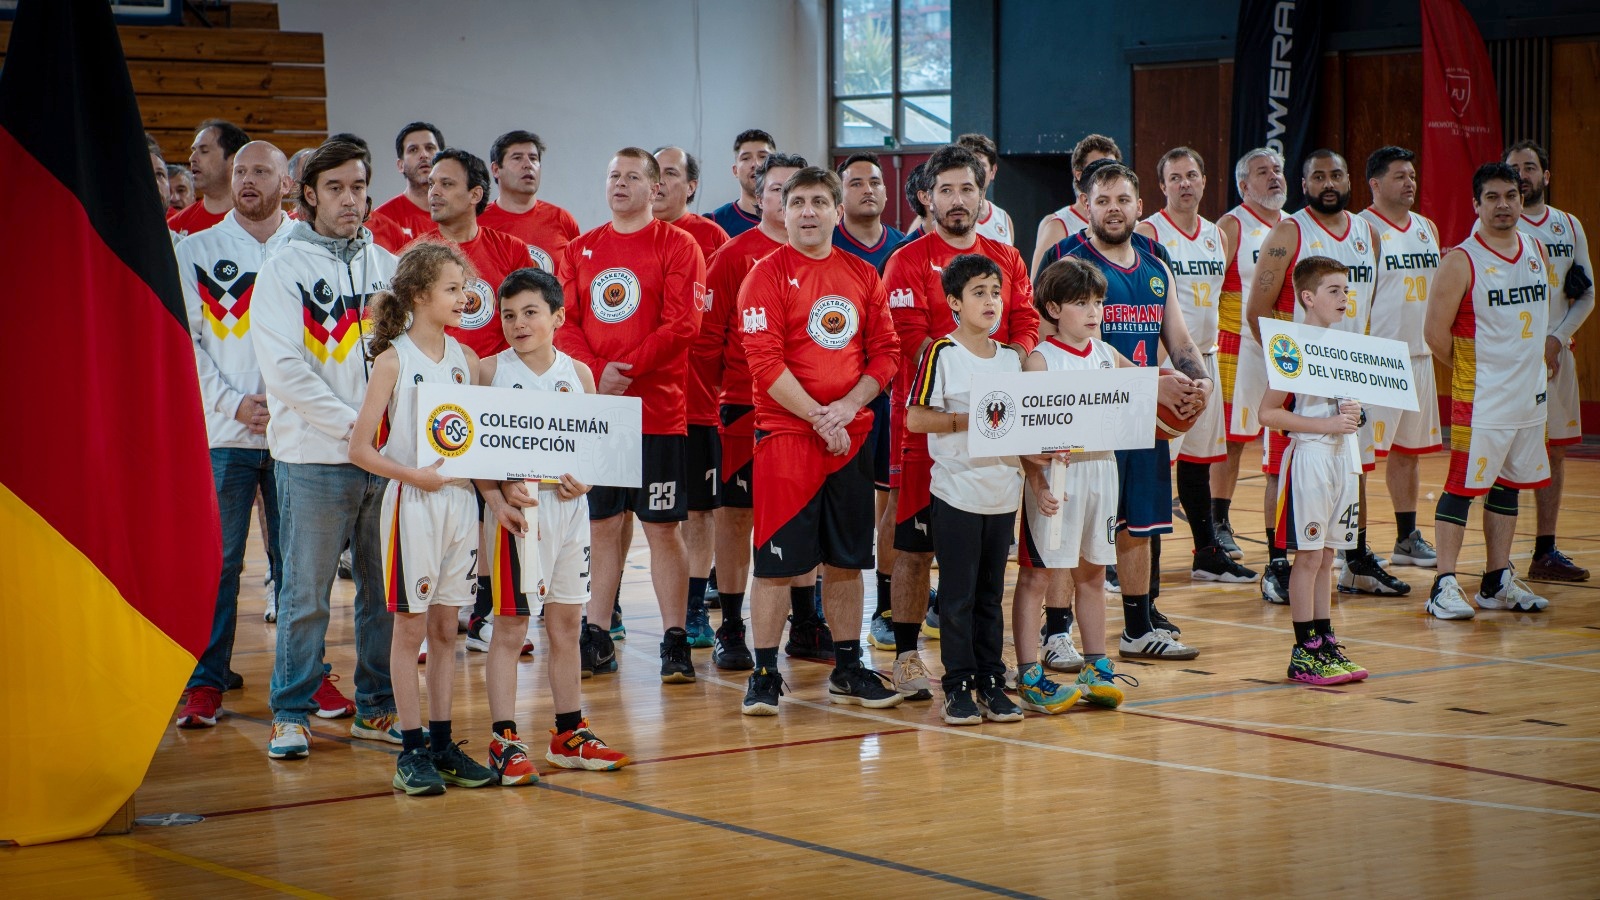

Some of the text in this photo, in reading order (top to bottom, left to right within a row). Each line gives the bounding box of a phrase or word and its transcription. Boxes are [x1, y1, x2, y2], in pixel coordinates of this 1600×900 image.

[1266, 0, 1296, 154] OWERA
[1385, 249, 1440, 271] ALEMÁN
[1545, 240, 1574, 258] MÁN
[1171, 257, 1224, 276] ALEMÁN
[1348, 261, 1373, 283] MÁN
[597, 273, 633, 287] BASKETBALL
[1404, 276, 1427, 302] 20
[1191, 282, 1213, 307] 12
[815, 301, 851, 317] BASKETBALL
[1105, 322, 1158, 332] BASKETBALL
[1519, 311, 1533, 339] 2
[1133, 340, 1148, 367] 4
[1304, 343, 1348, 361] COLEGIO
[1350, 351, 1405, 371] GERMANIA
[1282, 362, 1293, 371] CG
[1307, 363, 1408, 391] DEL VERBO DIVINO
[1021, 389, 1130, 409] COLEGIO ALEMÁN
[446, 419, 467, 442] DSC
[480, 412, 609, 435] COLEGIO ALEMÁN
[1021, 412, 1073, 427] TEMUCO
[480, 434, 576, 453] CONCEPCIÓN
[1474, 456, 1488, 482] 2
[704, 467, 717, 496] 7
[648, 480, 676, 511] 23
[1338, 501, 1360, 530] 45
